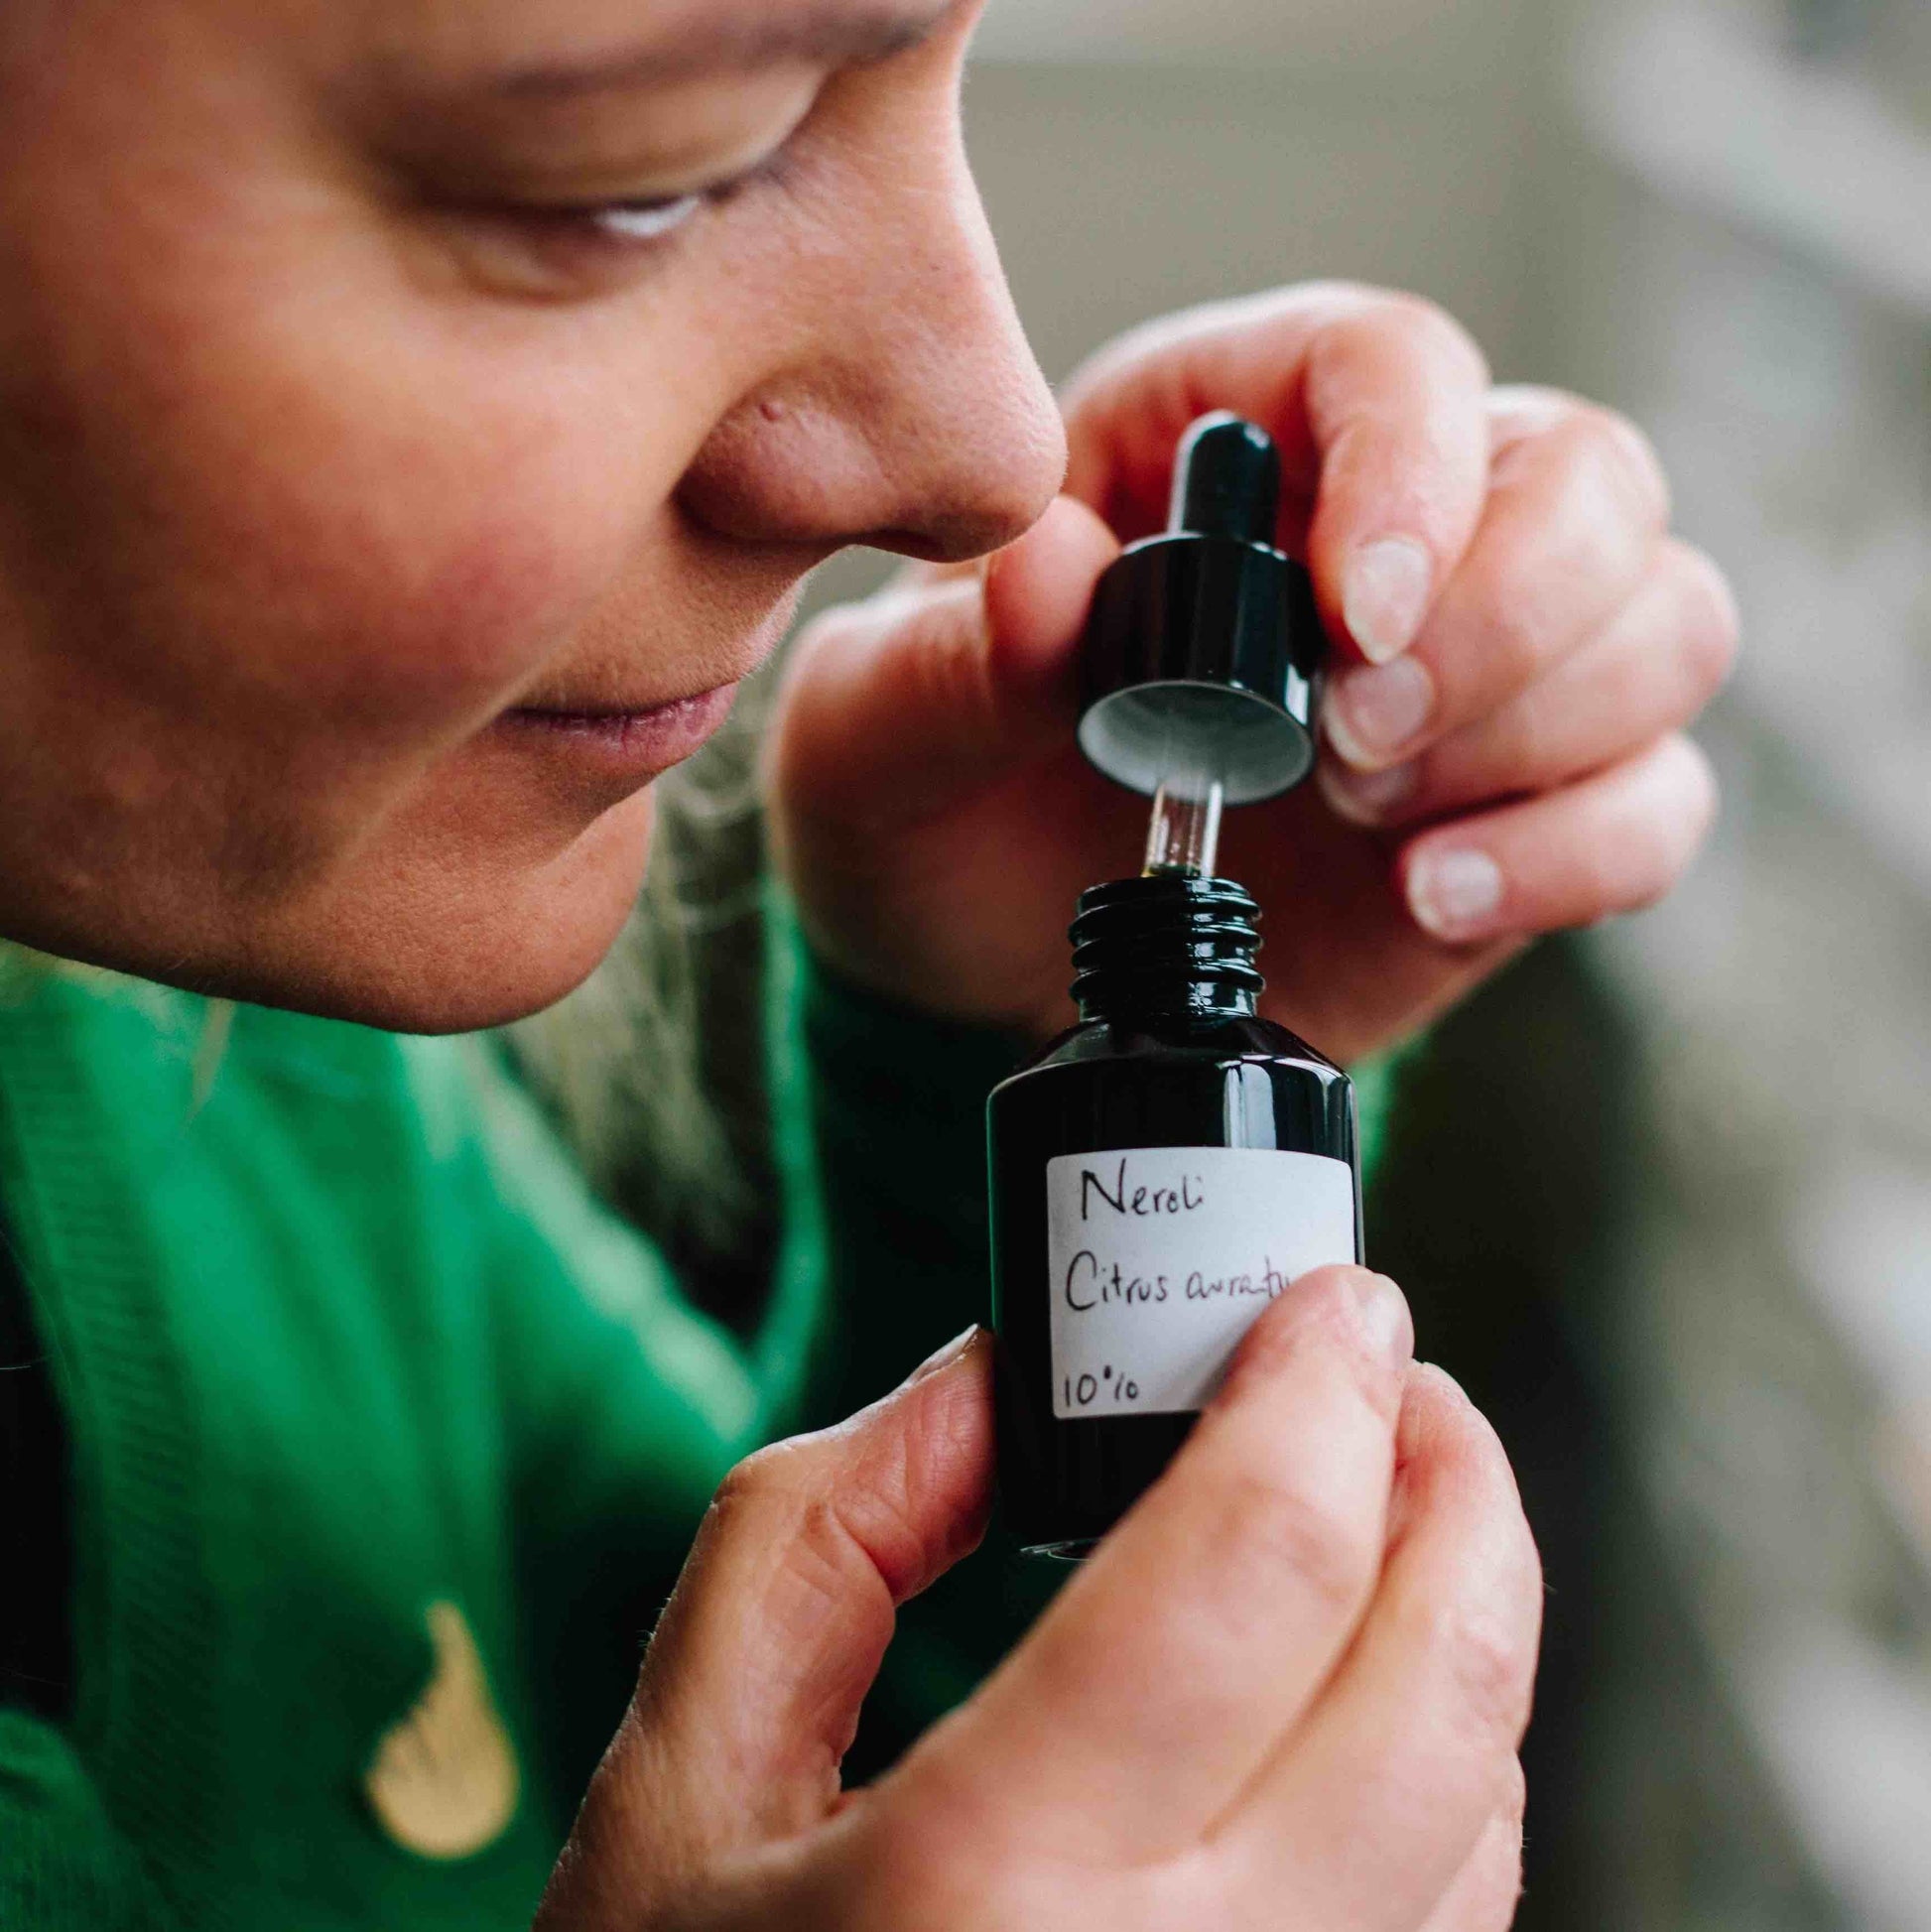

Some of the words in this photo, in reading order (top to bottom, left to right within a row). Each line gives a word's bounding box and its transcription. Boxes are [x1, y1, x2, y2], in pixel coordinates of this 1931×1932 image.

[1081, 1158, 1204, 1221] Neroli
[1066, 1250, 1168, 1311] Citrus
[1065, 1364, 1139, 1408] 10%
